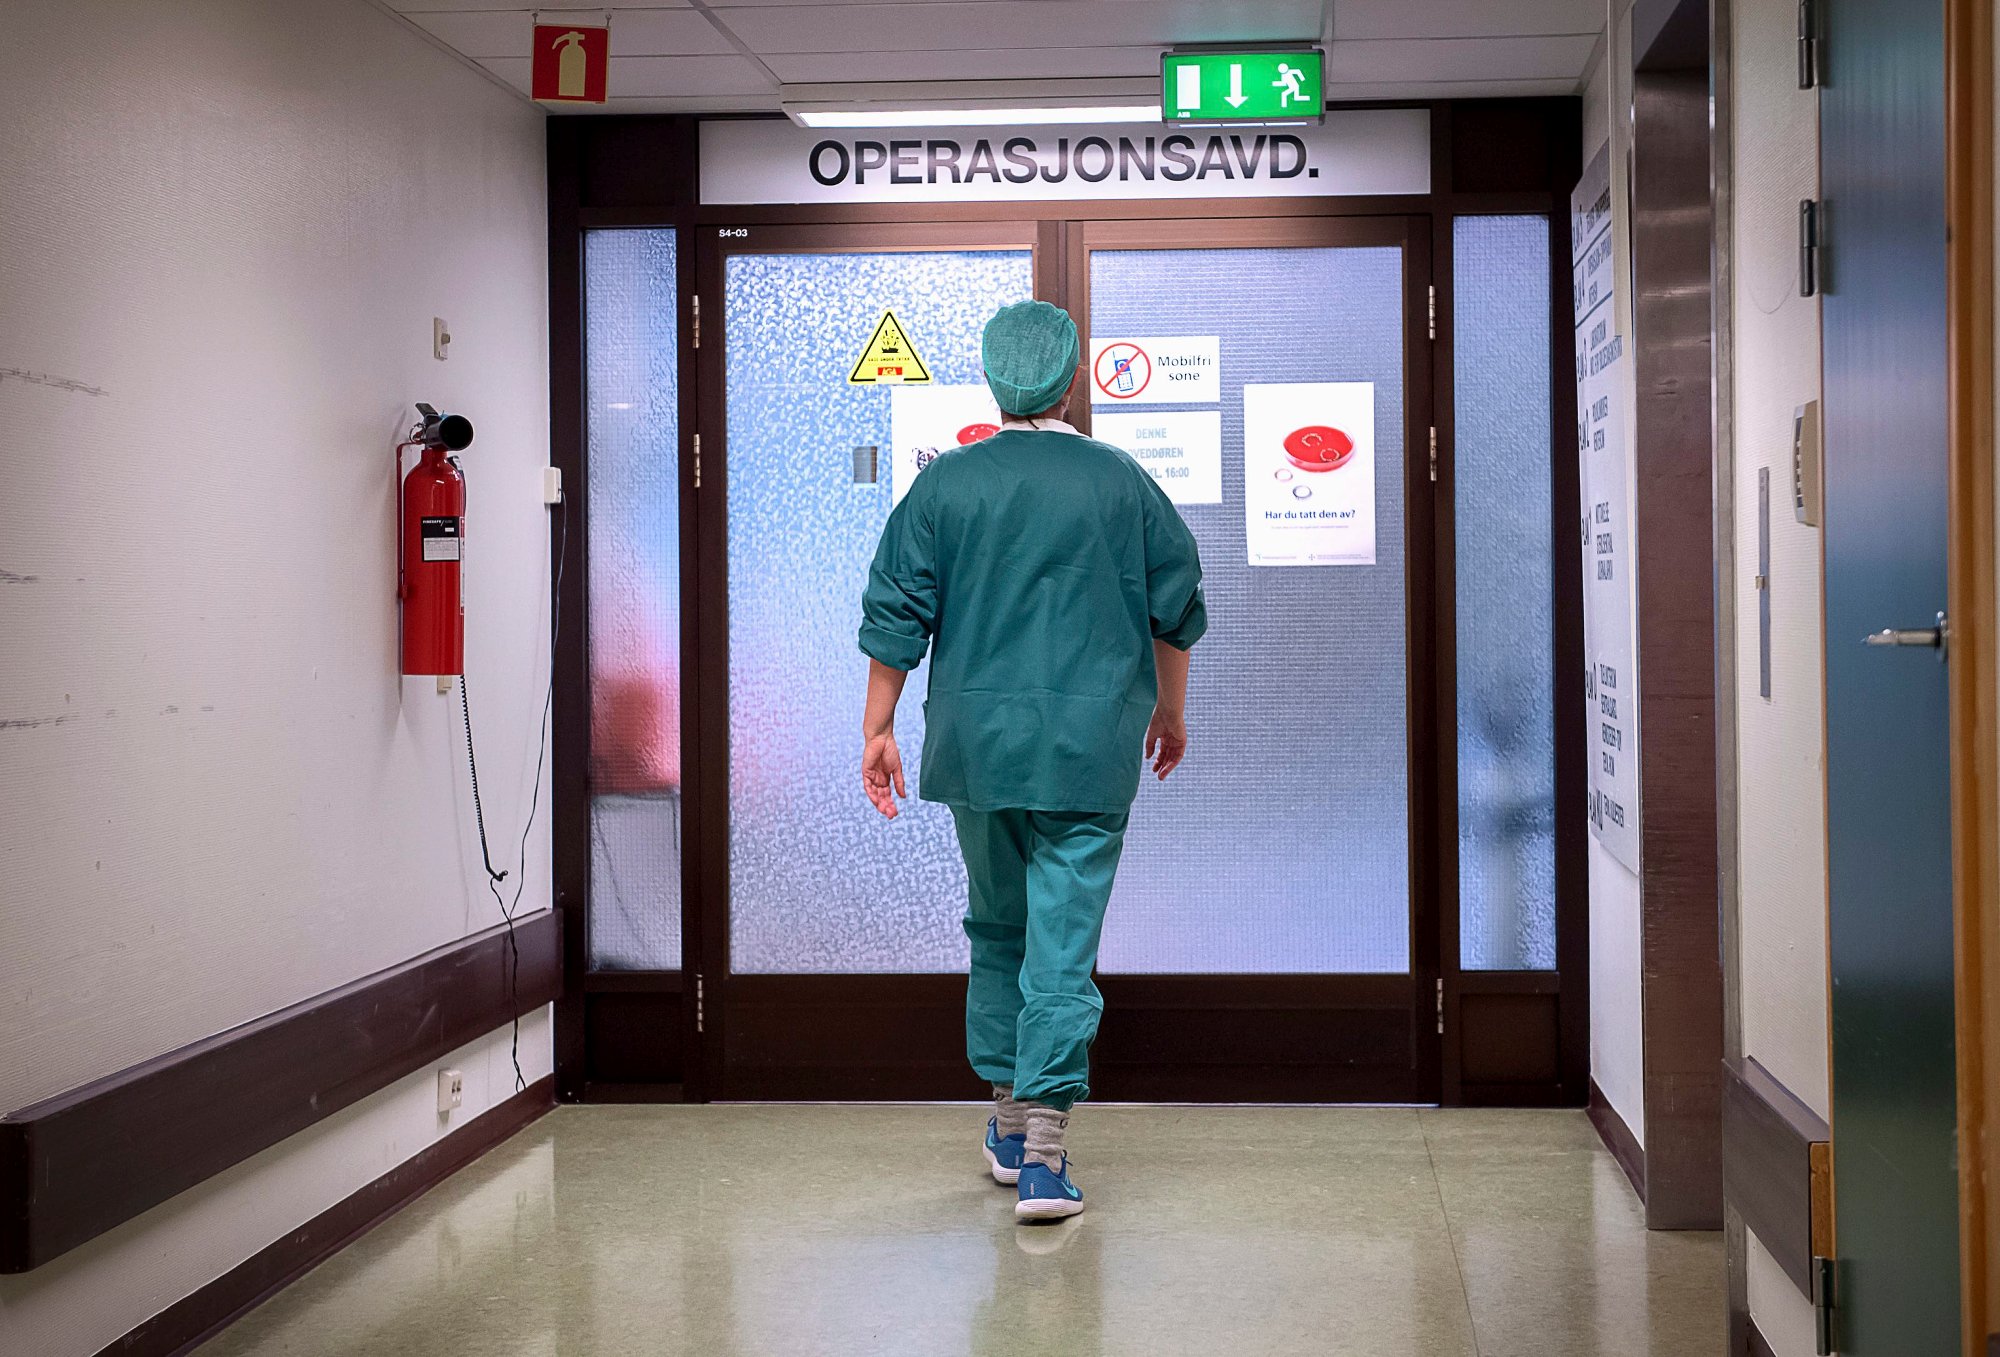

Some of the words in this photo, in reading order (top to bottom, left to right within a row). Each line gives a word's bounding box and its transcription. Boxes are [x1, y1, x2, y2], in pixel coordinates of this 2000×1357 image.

[808, 134, 1319, 187] OPERASJONSAVD.
[718, 229, 748, 238] S4-03
[1158, 355, 1211, 367] Mobilfri
[1168, 371, 1200, 381] sone
[1135, 428, 1167, 439] DENNE
[1127, 447, 1184, 459] OVEDDØREN
[1165, 467, 1190, 478] 16:00
[1265, 510, 1282, 519] Har
[1284, 510, 1297, 519] du
[1300, 510, 1317, 519] tatt
[1318, 510, 1337, 519] den
[1339, 509, 1356, 519] av?
